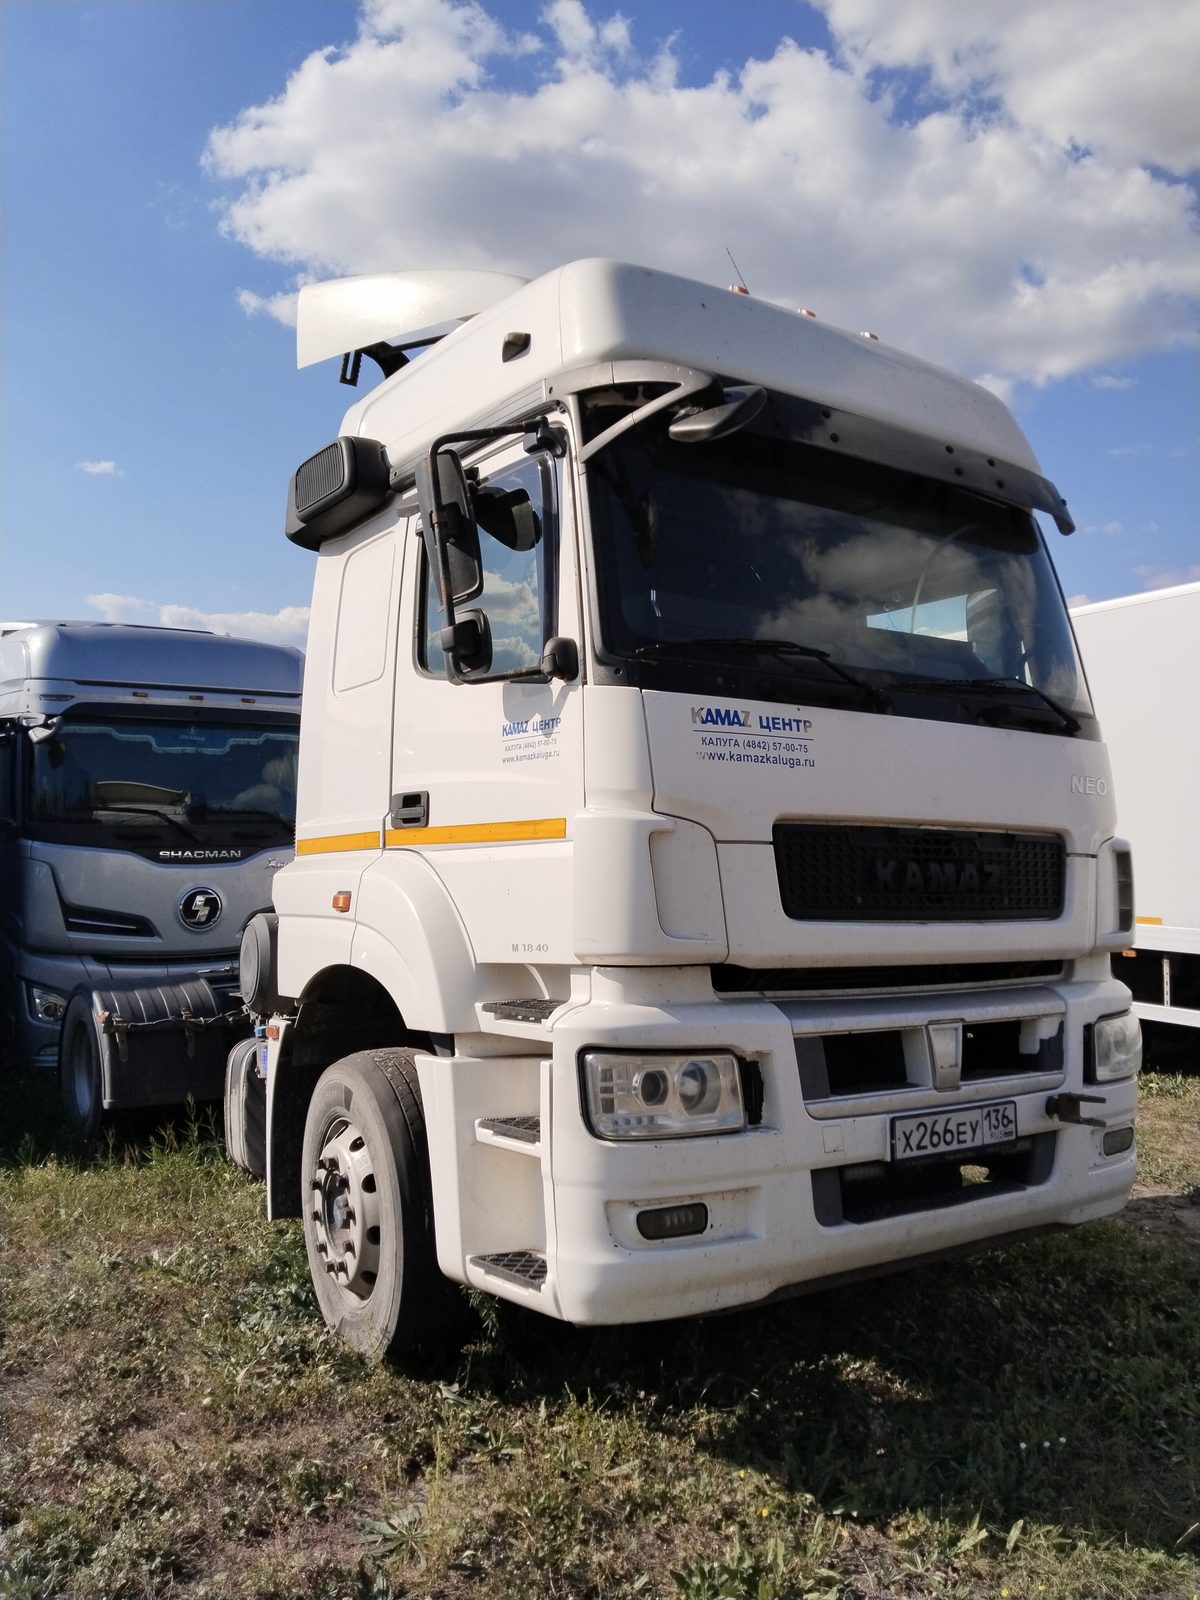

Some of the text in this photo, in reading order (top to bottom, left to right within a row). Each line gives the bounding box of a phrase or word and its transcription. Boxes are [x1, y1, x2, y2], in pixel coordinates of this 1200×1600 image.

[502, 717, 561, 737] KAMAZ ЦЕНТР
[691, 707, 813, 733] KAMAZ ЦЕНТР
[701, 737, 809, 754] КАЛУГА (4842) 57-00-75
[502, 750, 560, 764] www.kamazkaluga.ru
[1071, 775, 1106, 796] NEO
[159, 850, 242, 859] SHACMAN
[873, 860, 1003, 893] KAMAZ
[984, 1106, 1010, 1131] 136
[990, 1130, 1004, 1140] RUS
